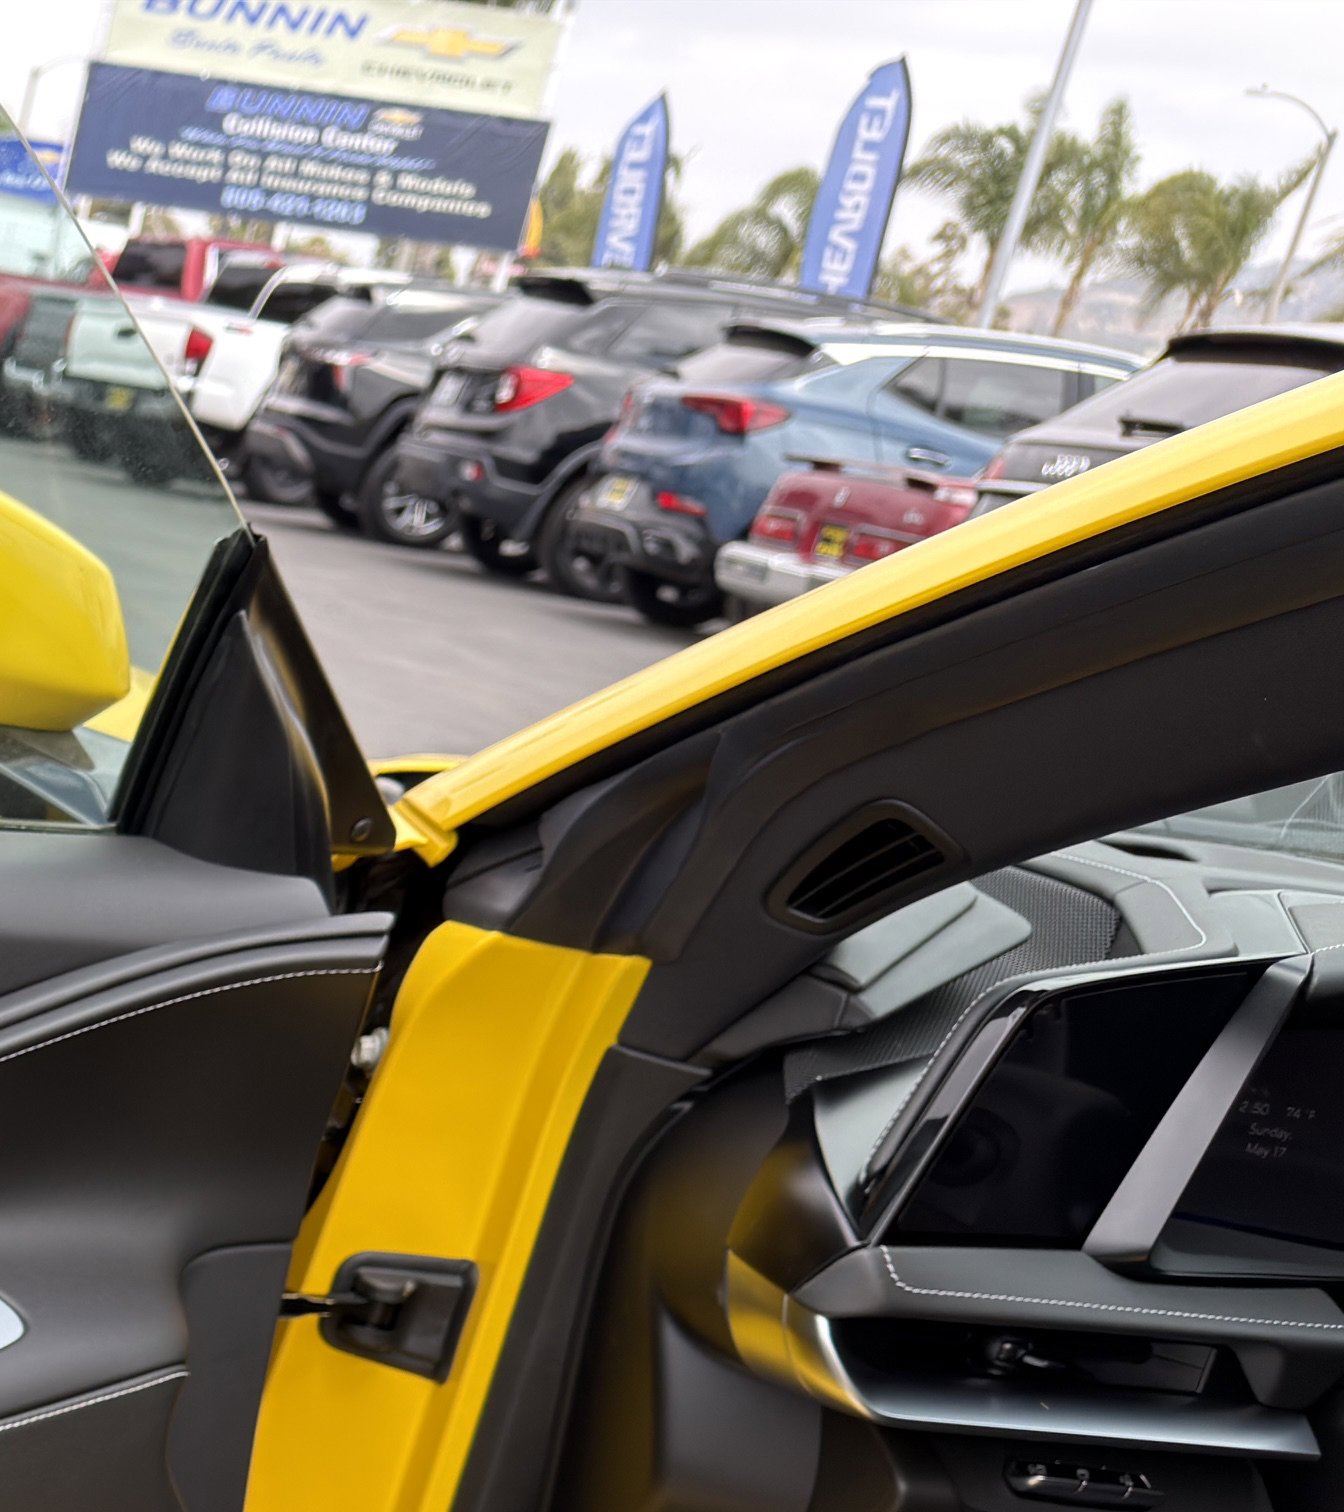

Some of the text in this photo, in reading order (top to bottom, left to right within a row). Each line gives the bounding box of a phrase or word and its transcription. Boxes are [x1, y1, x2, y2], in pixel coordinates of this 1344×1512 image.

[142, 0, 368, 41] BUNNIN
[205, 84, 371, 131] BUNNIN
[320, 125, 399, 155] Center
[1246, 1142, 1269, 1159] May
